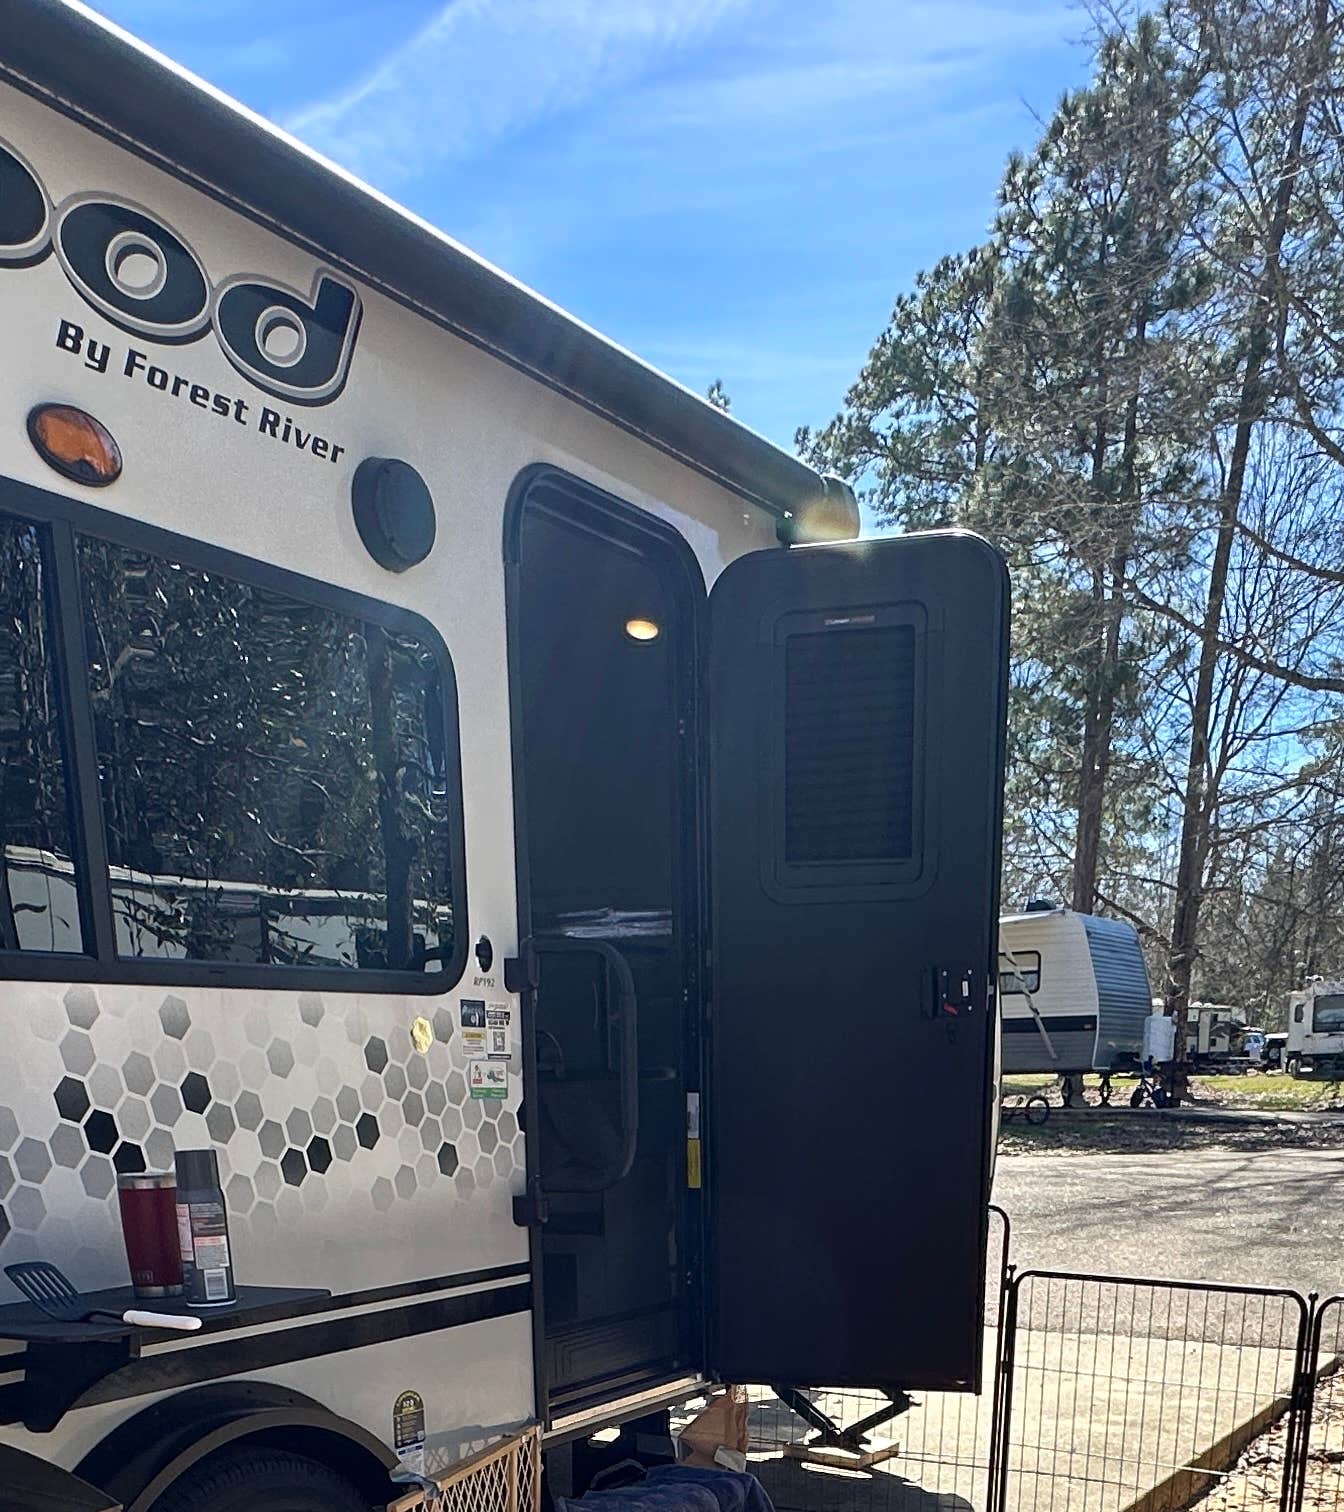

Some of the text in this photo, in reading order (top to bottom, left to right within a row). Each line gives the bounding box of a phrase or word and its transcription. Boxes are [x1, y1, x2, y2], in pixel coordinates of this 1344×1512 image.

[56, 320, 345, 463] By Forest River
